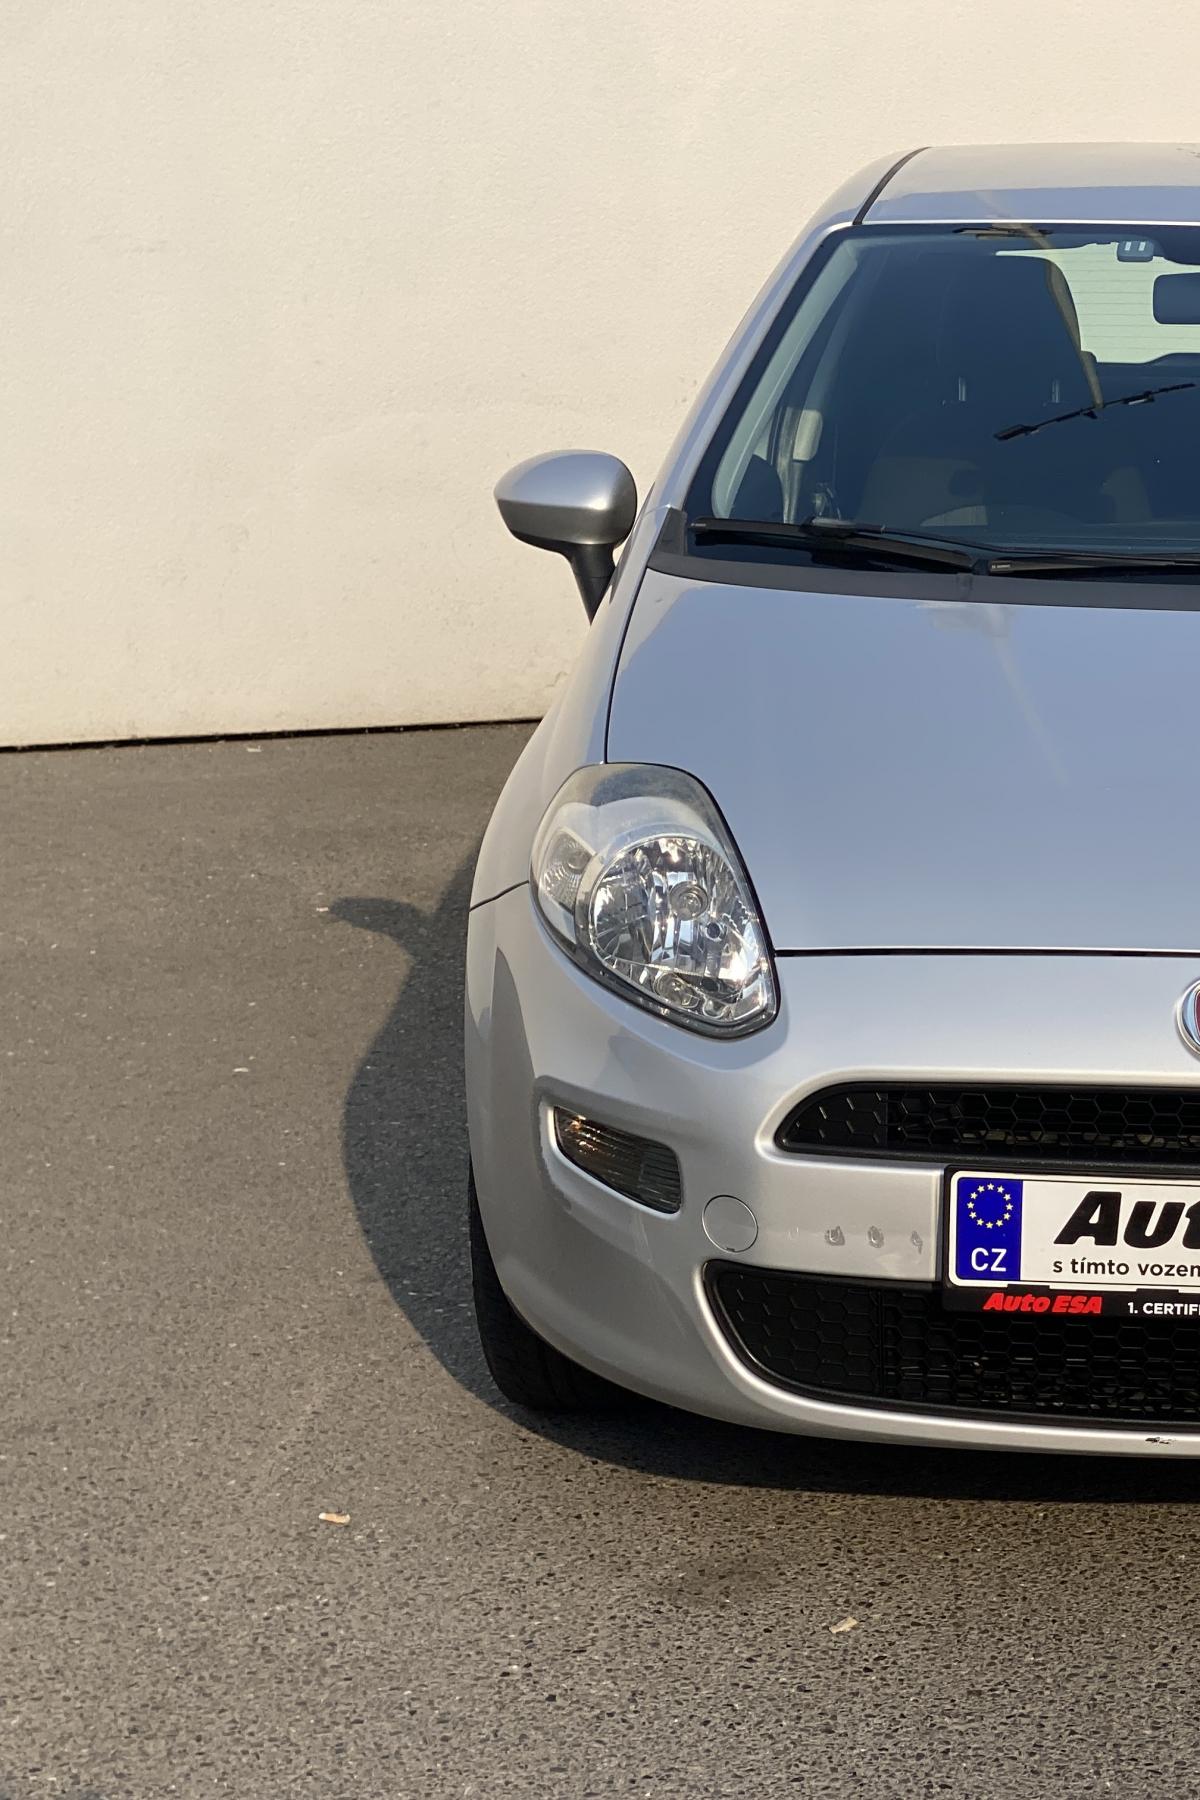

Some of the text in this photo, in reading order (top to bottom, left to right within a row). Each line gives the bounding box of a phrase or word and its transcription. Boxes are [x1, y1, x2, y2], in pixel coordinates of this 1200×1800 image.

[970, 1246, 1008, 1273] CZ
[1052, 1259, 1064, 1274] s
[1069, 1256, 1130, 1276] tímto
[983, 1292, 1103, 1315] Auto ESA
[1127, 1301, 1139, 1315] 1.
